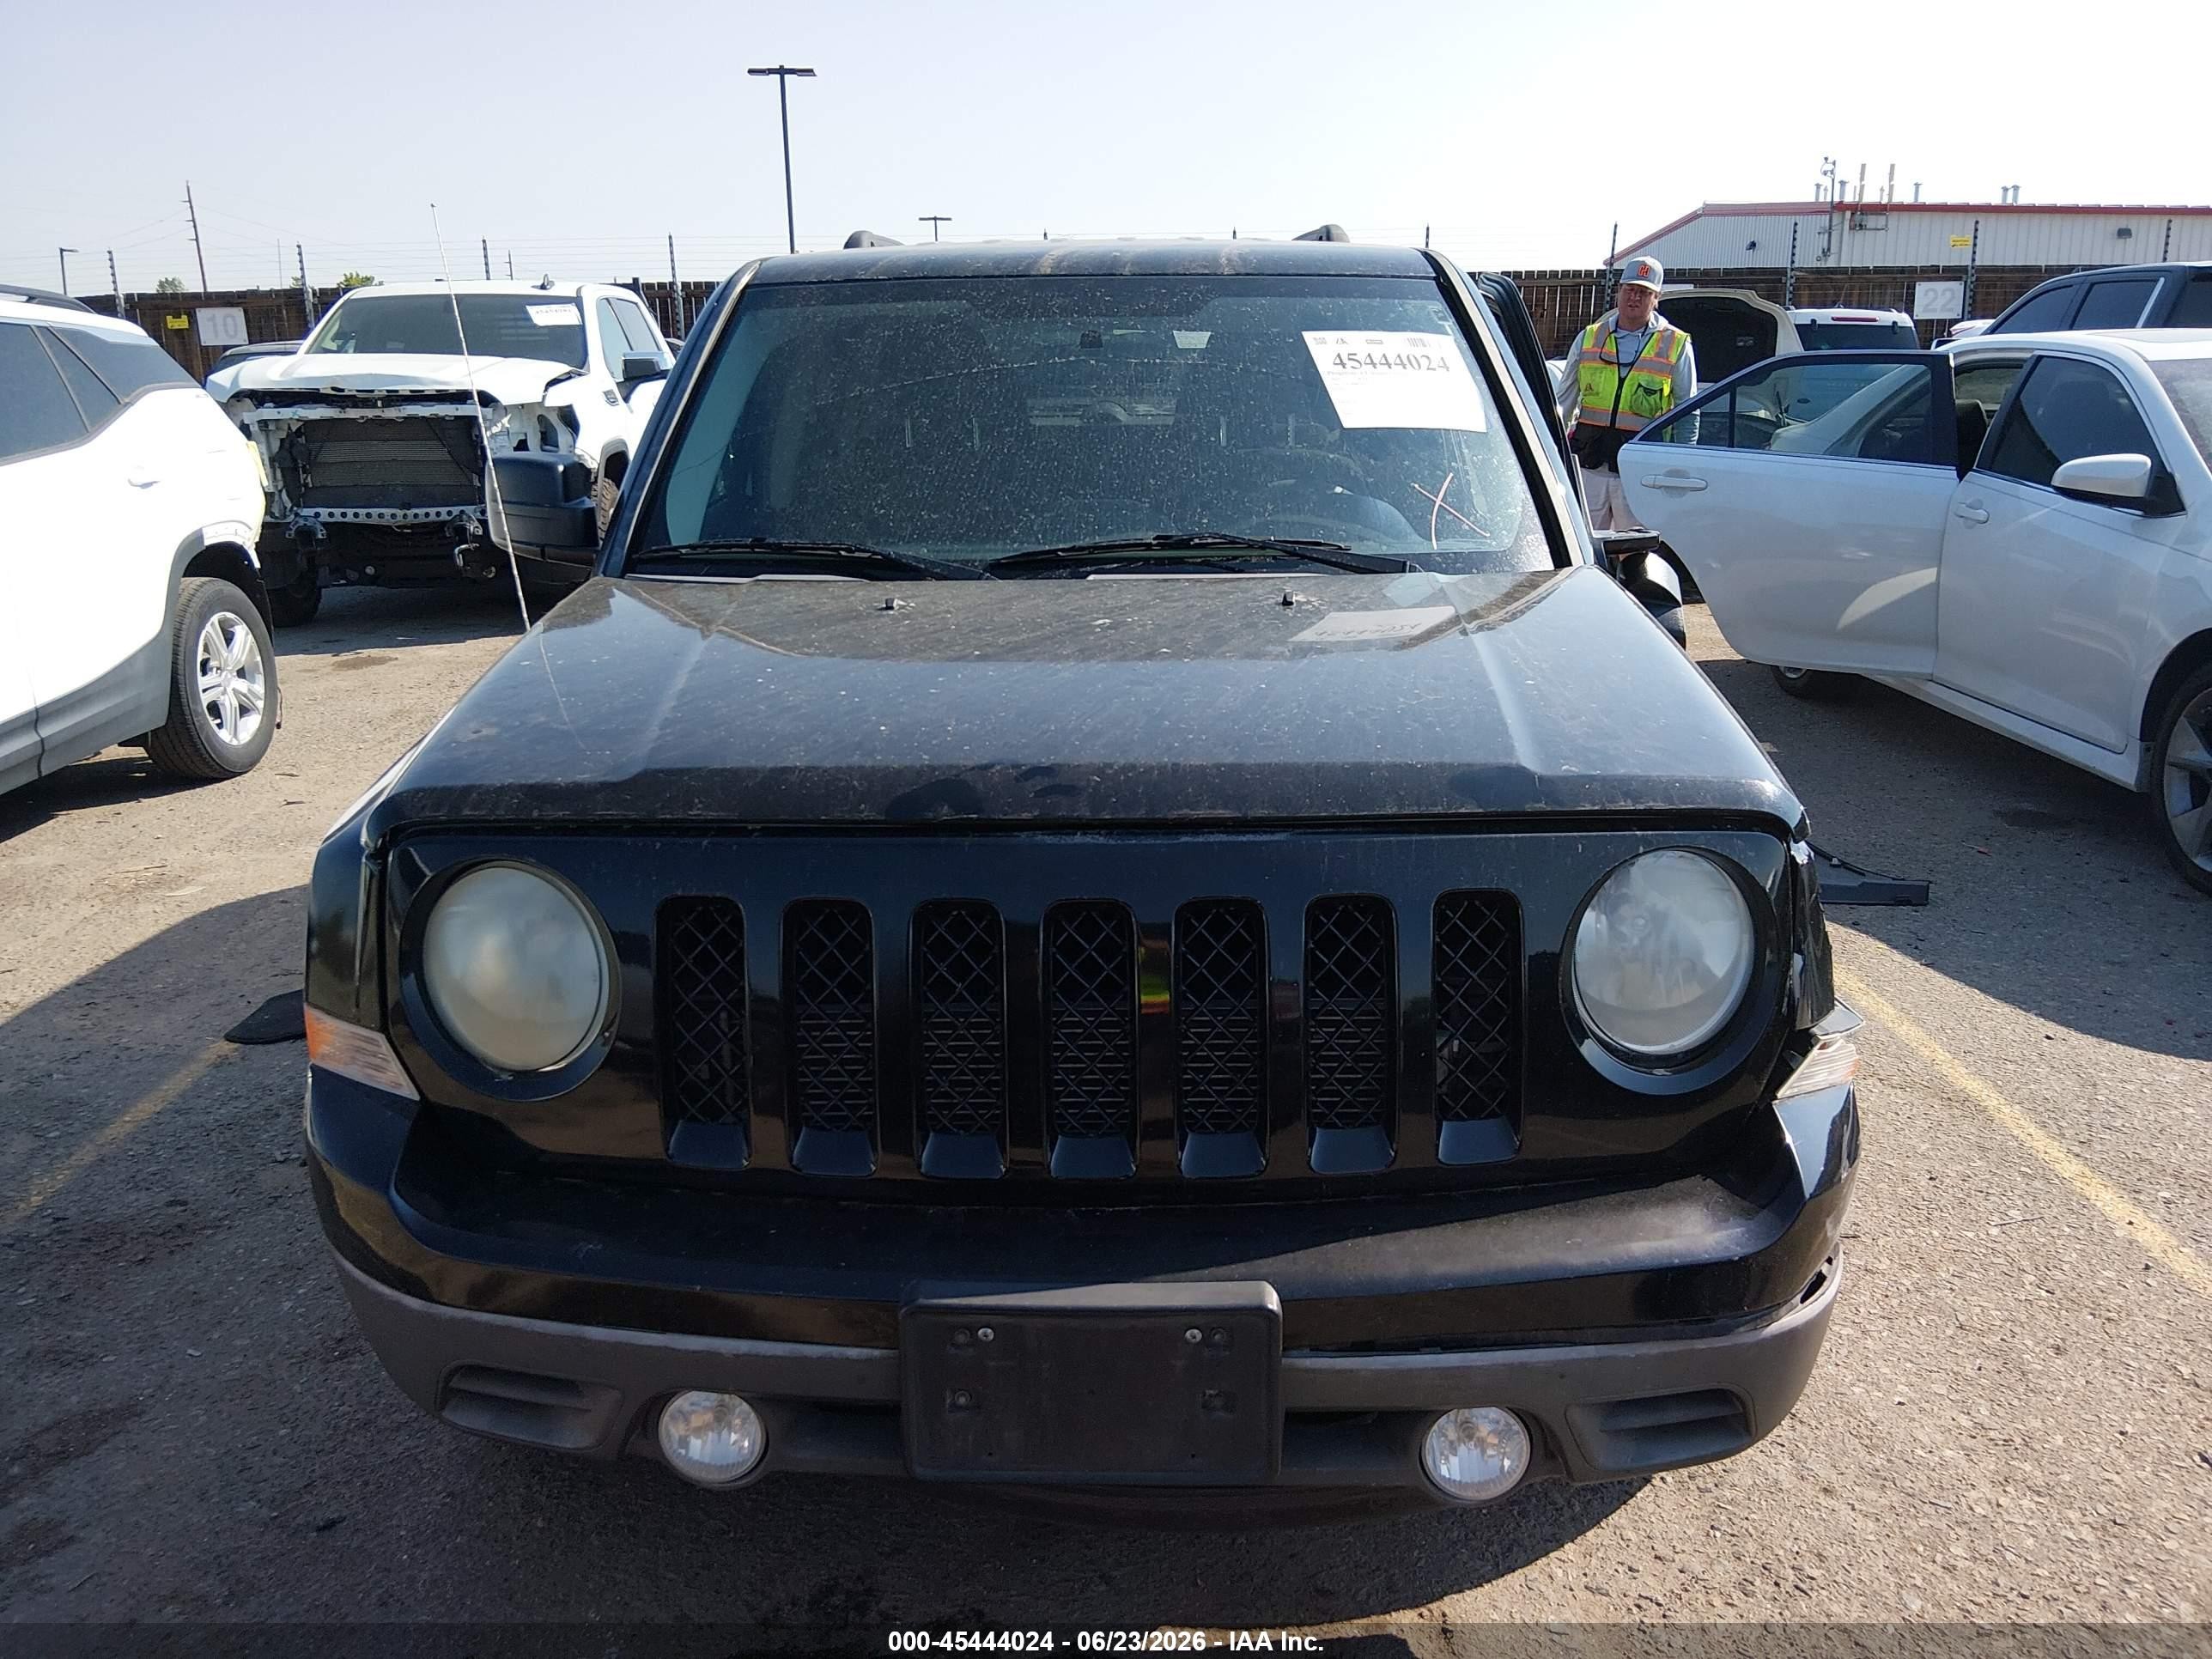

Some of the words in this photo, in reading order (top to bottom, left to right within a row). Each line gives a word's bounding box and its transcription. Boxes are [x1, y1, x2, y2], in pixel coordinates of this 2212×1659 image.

[1922, 287, 1956, 313] 22
[206, 313, 239, 340] 10
[1332, 352, 1451, 372] 45444024
